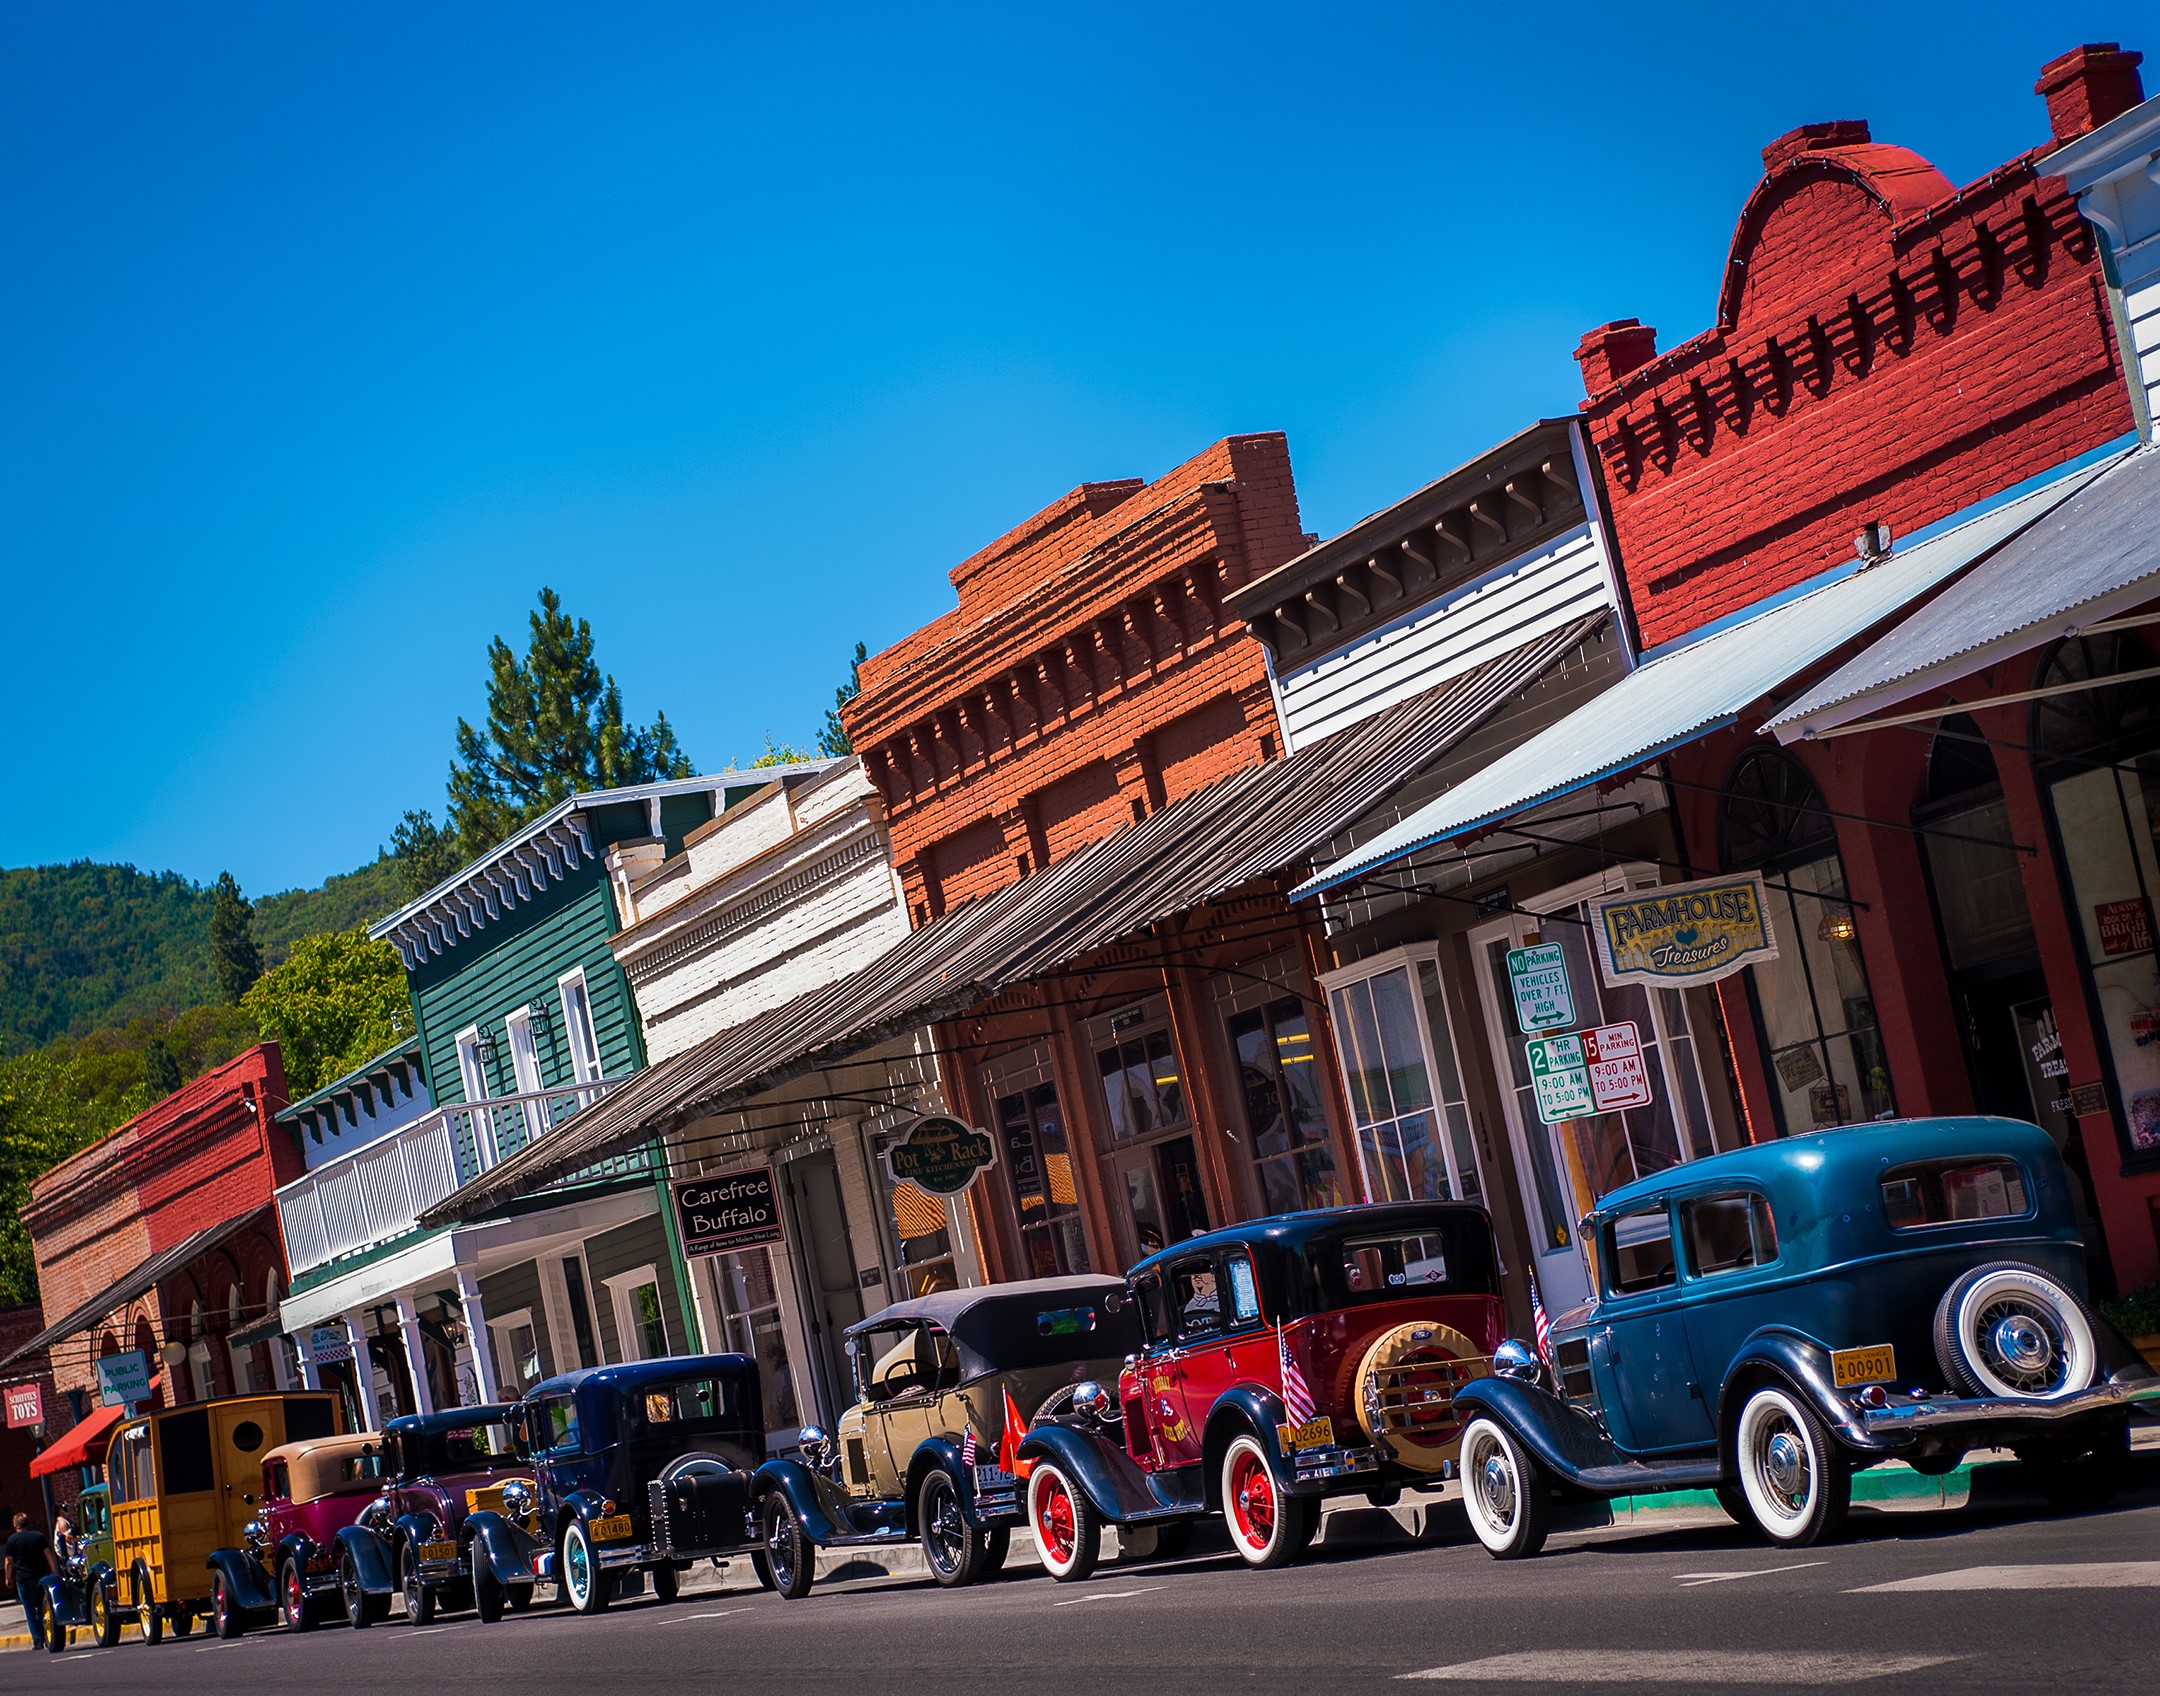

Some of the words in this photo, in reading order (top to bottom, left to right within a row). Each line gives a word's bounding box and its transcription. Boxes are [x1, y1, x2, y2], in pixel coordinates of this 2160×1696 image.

[1610, 890, 1756, 947] FARMHOUSE
[2103, 914, 2121, 925] look
[2121, 912, 2132, 922] on
[2100, 919, 2147, 938] BRIGH
[1510, 955, 1525, 973] NO
[1526, 950, 1560, 967] PARKING
[1652, 937, 1728, 967] Treasures
[1519, 971, 1560, 988] VEHICLES
[1520, 988, 1543, 1003] OVER
[1545, 987, 1550, 998] 7
[1553, 984, 1567, 996] FT.
[1534, 1000, 1556, 1013] HIGH
[1555, 1039, 1571, 1053] HR
[1600, 1038, 1635, 1053] PARKING
[1607, 1032, 1623, 1042] MIN
[1582, 1037, 1598, 1058] 15
[1532, 1047, 1546, 1069] 2
[1549, 1051, 1582, 1067] PARKING
[1594, 1062, 1618, 1078] 9:00
[1622, 1059, 1636, 1073] AM
[1541, 1076, 1565, 1090] 9:00
[1569, 1071, 1583, 1086] AM
[1595, 1081, 1606, 1093] TO
[1609, 1076, 1628, 1091] 5:00
[1631, 1074, 1643, 1087] PM
[1542, 1094, 1553, 1106] TO
[1556, 1089, 1575, 1104] 5:00
[1578, 1087, 1589, 1099] PM
[895, 1151, 920, 1170] Pot
[949, 1138, 989, 1162] Rack
[905, 1166, 925, 1177] FINE
[925, 1158, 982, 1173] KITCHENWARE
[682, 1181, 769, 1207] Carefree
[692, 1206, 766, 1233] Buffalo
[695, 1244, 709, 1253] Range
[736, 1235, 754, 1244] Modern
[754, 1233, 766, 1241] West
[766, 1231, 780, 1239] Living
[1864, 1351, 1887, 1359] VEHICLE
[104, 1363, 140, 1379] PUBLIC
[1848, 1357, 1891, 1378] 00901
[104, 1377, 146, 1395] PARKING
[1854, 1375, 1878, 1383] OREGON
[11, 1400, 38, 1421] TOYS
[1295, 1424, 1330, 1442] 02696
[601, 1522, 630, 1537] 01480
[428, 1547, 455, 1558] 01501
